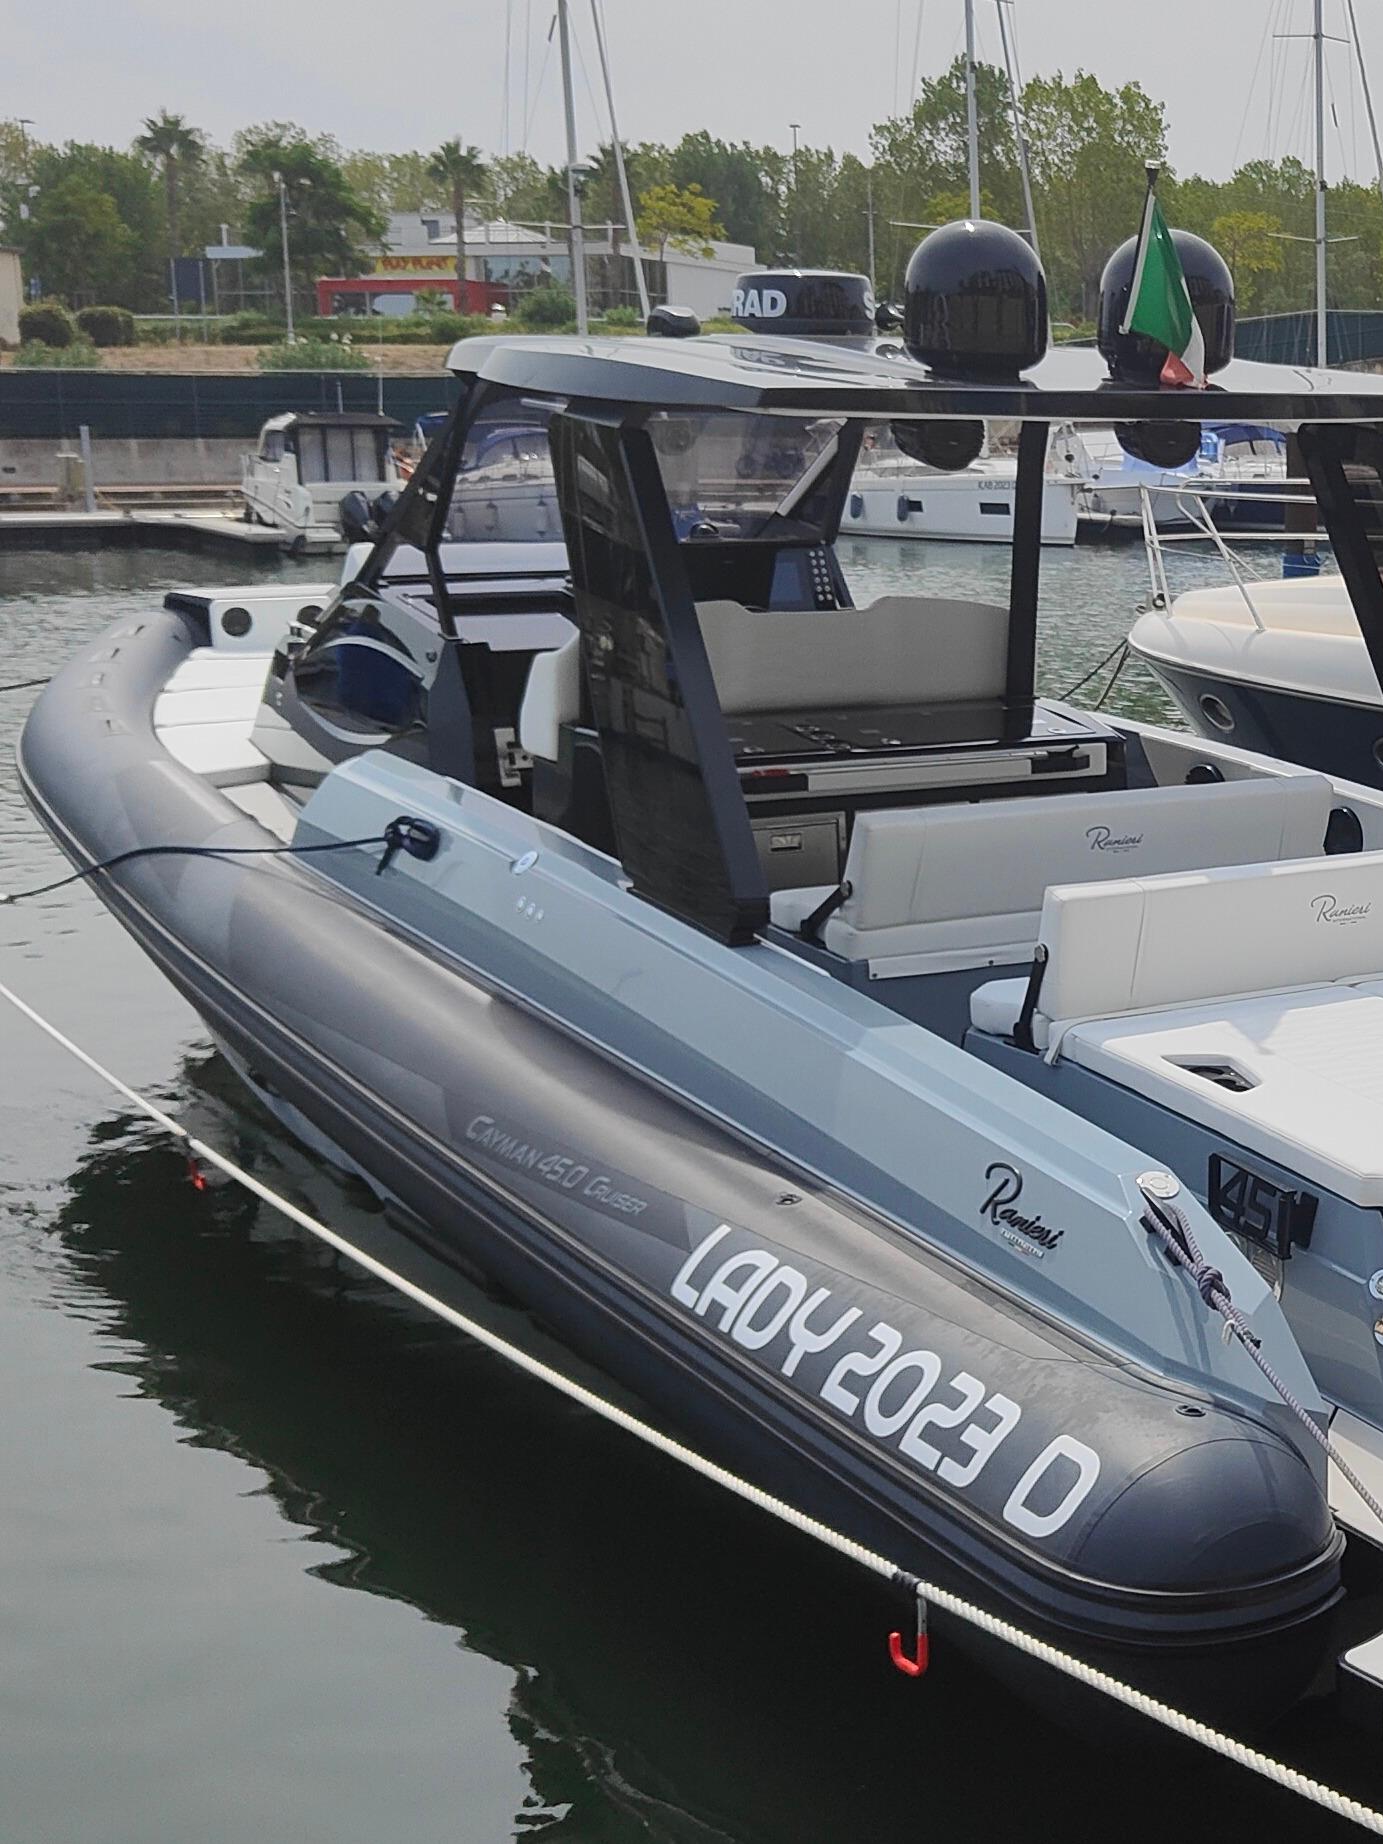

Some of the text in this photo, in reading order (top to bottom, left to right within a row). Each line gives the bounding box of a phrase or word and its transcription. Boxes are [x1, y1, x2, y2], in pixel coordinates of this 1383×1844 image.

[465, 1115, 543, 1169] CAYMAN
[979, 1162, 1064, 1250] Ranieri
[671, 1224, 1101, 1538] LADY 2023 D
